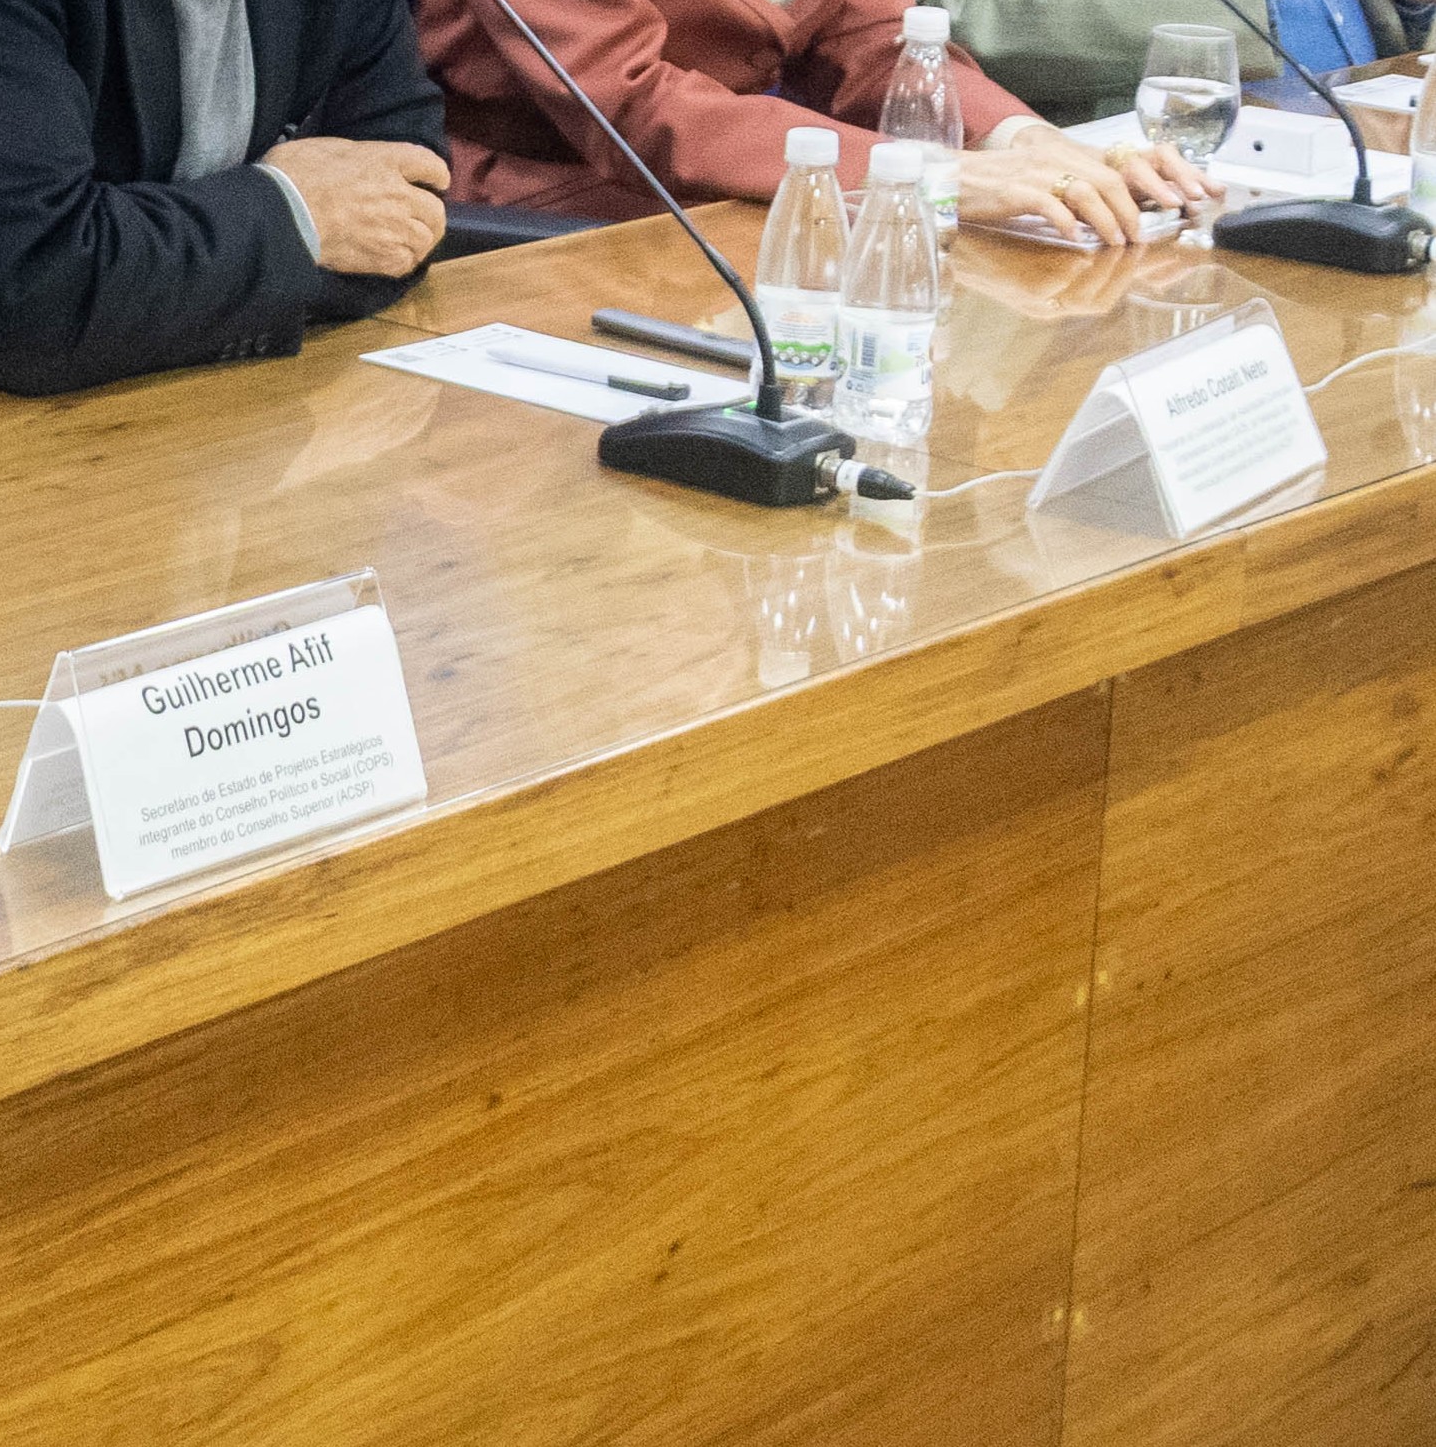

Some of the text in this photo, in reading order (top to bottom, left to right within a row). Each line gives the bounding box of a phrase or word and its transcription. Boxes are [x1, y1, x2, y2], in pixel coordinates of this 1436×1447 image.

[141, 633, 334, 715] Guilherme Afif
[184, 696, 322, 758] Domingos
[139, 751, 394, 846] integrante do Conselho Político e Social (COPS)
[140, 734, 383, 823] Secretário de Estado de Projetos Estratégicos
[171, 780, 375, 859] membro do Conselho Superior (ACSP)
